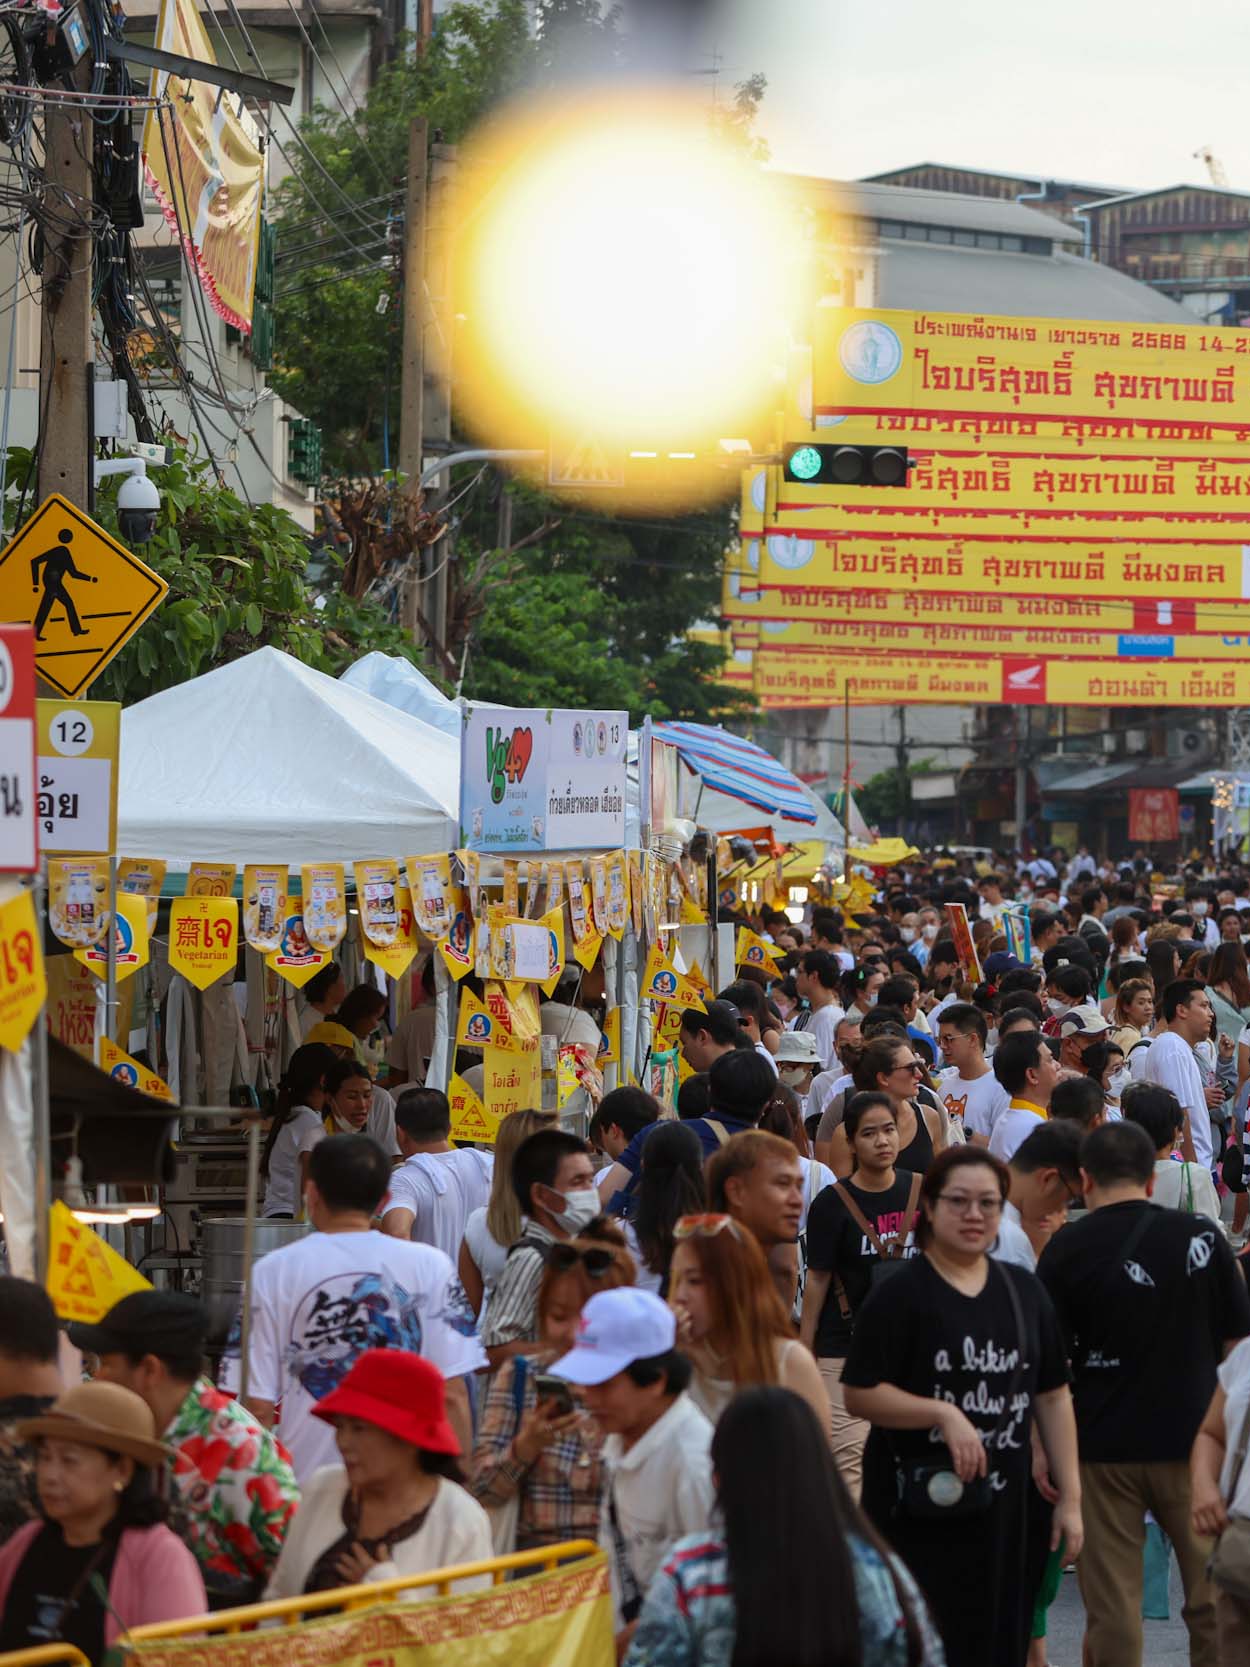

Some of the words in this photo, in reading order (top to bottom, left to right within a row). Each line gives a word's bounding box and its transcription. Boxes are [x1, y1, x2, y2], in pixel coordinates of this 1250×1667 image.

[1049, 329, 1120, 347] เยาวราช
[914, 347, 1075, 405] ใจบริสุทธิ์
[1094, 365, 1235, 409] สุขภาพดี
[1033, 457, 1176, 502] สุขภาพดี
[826, 542, 964, 583] ใจบริสุทธิ์
[983, 552, 1105, 586] สุขภาพดี
[1122, 552, 1225, 584] มีมงคล
[56, 721, 87, 743] 12
[610, 725, 620, 744] 13
[203, 917, 233, 949] เจ
[175, 948, 228, 961] Vegetarian
[934, 1350, 952, 1372] a
[962, 1380, 1030, 1423] alwys
